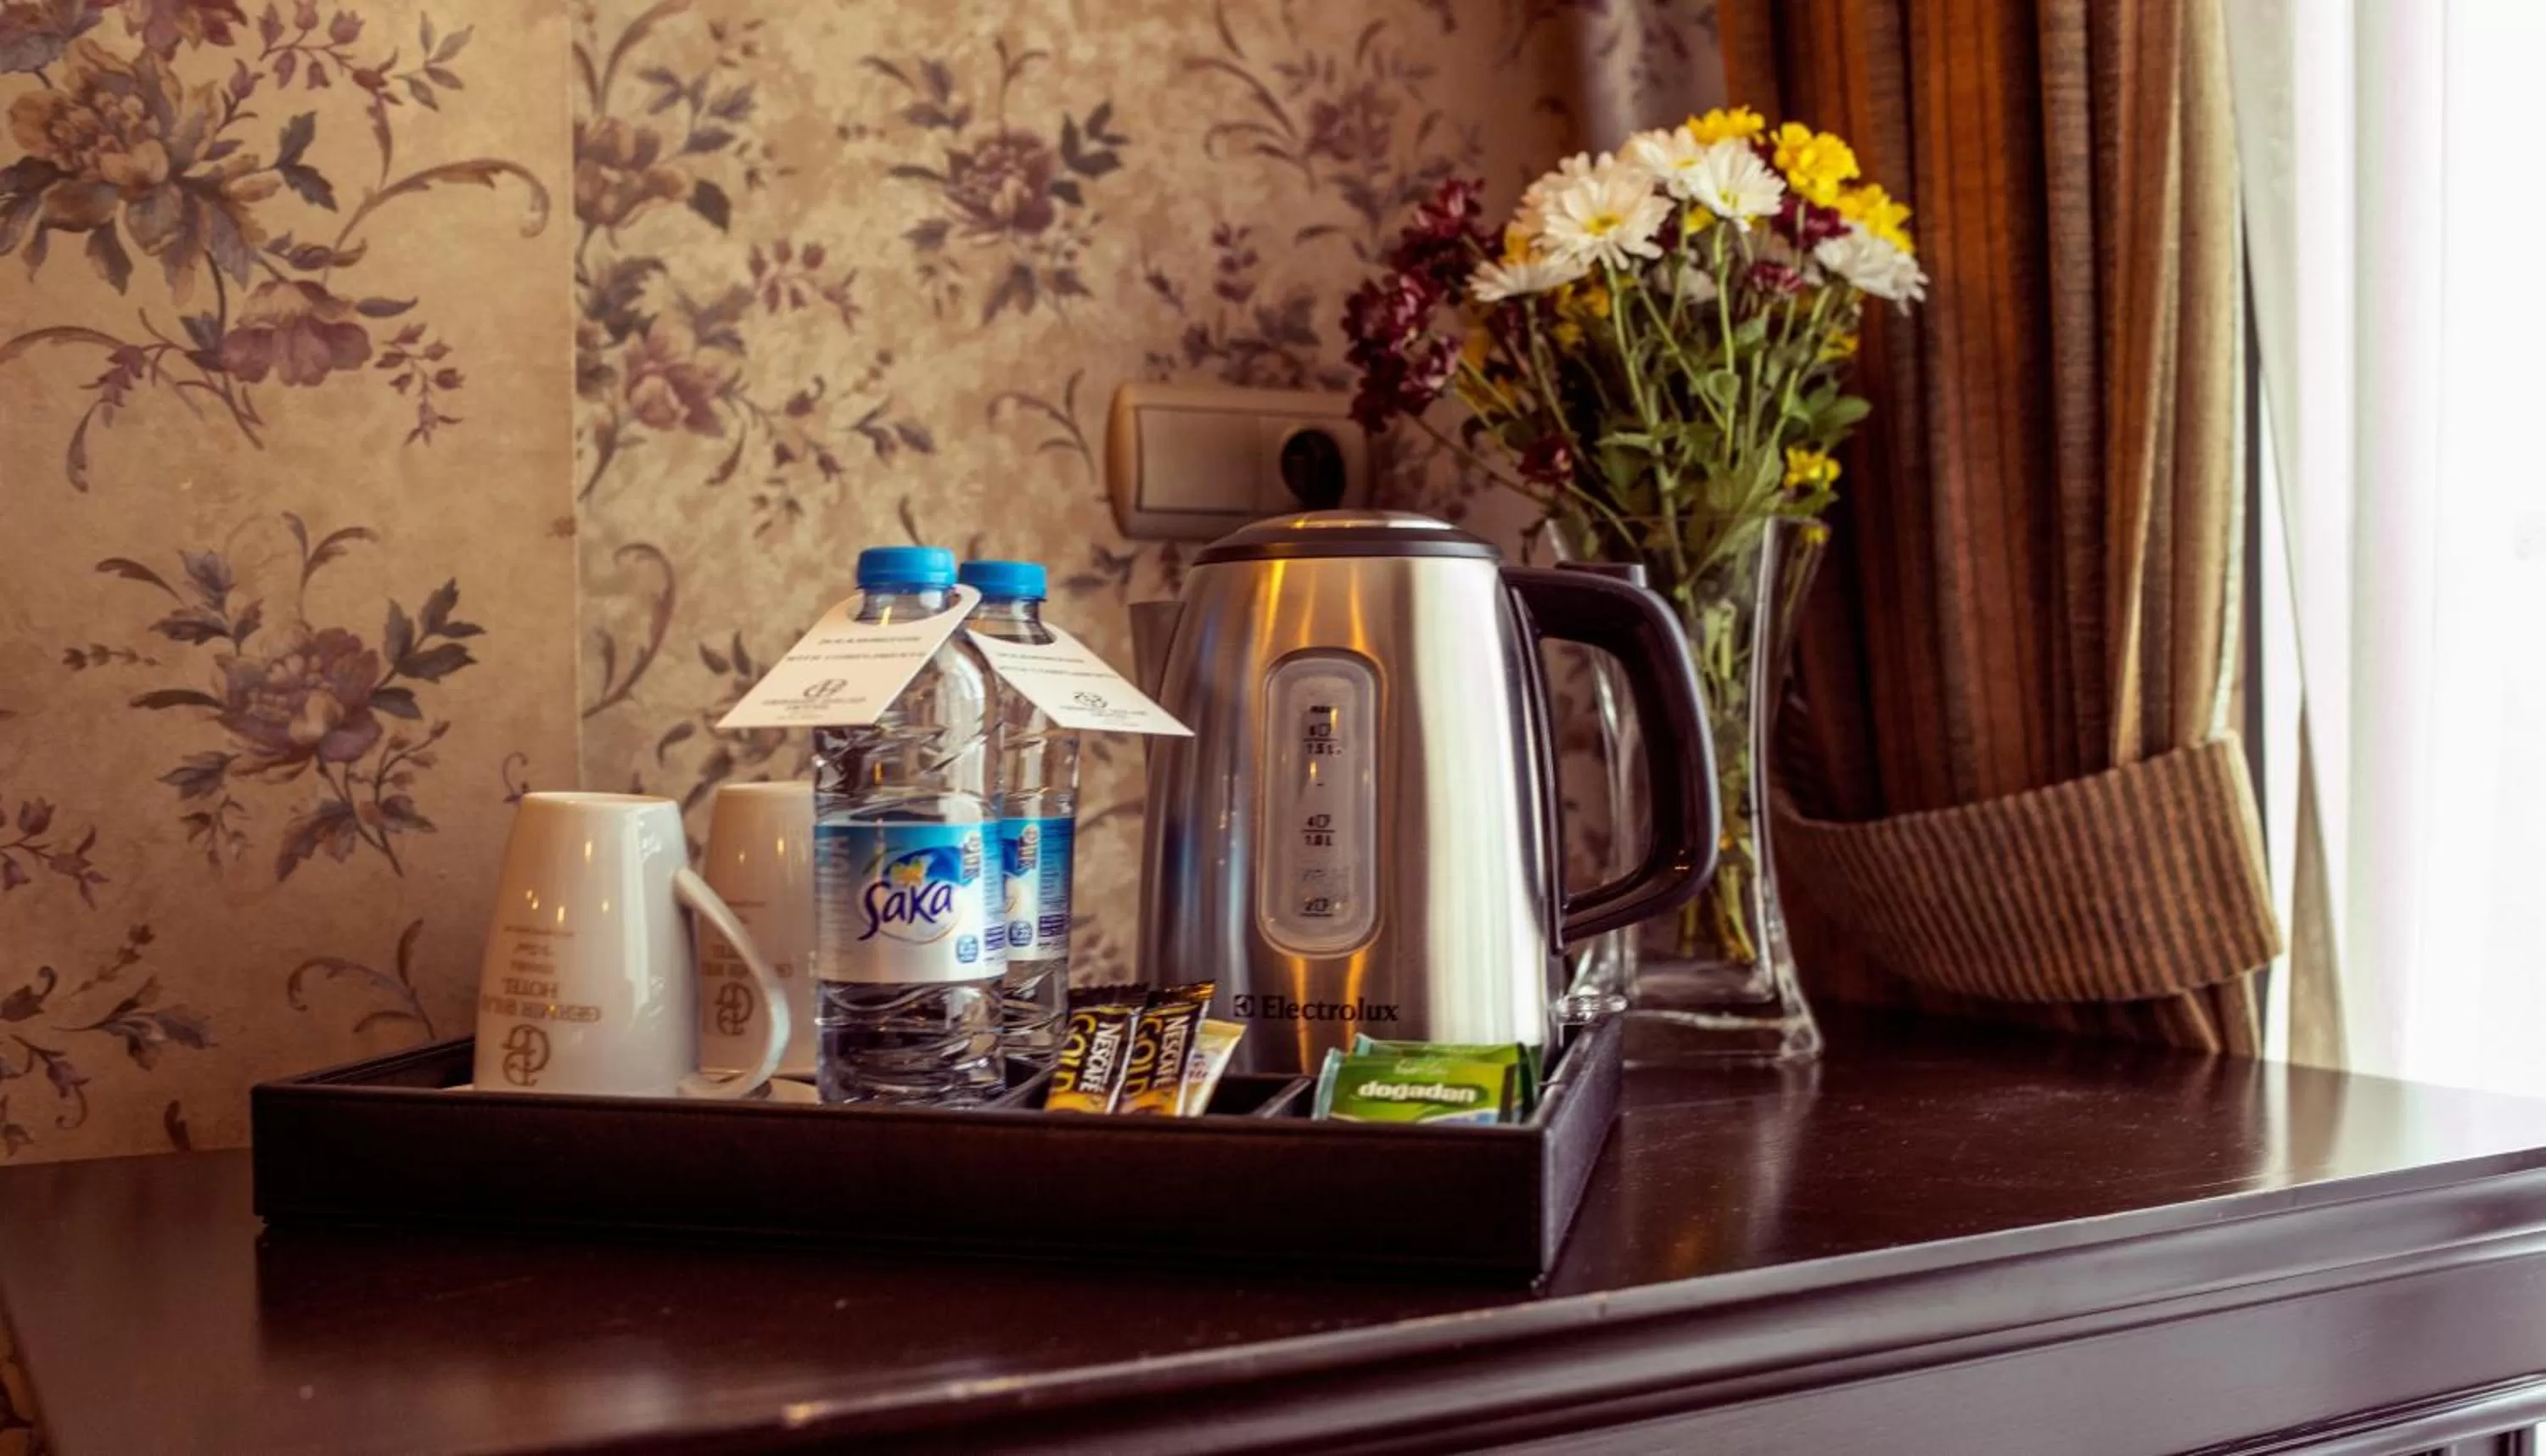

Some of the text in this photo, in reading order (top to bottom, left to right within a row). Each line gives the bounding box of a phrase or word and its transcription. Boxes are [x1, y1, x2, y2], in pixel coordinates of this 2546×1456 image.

[504, 978, 558, 999] HOTEL
[1261, 994, 1399, 1022] Electrolux
[1051, 1013, 1097, 1093] GOLD
[1123, 1016, 1164, 1097] GOLD
